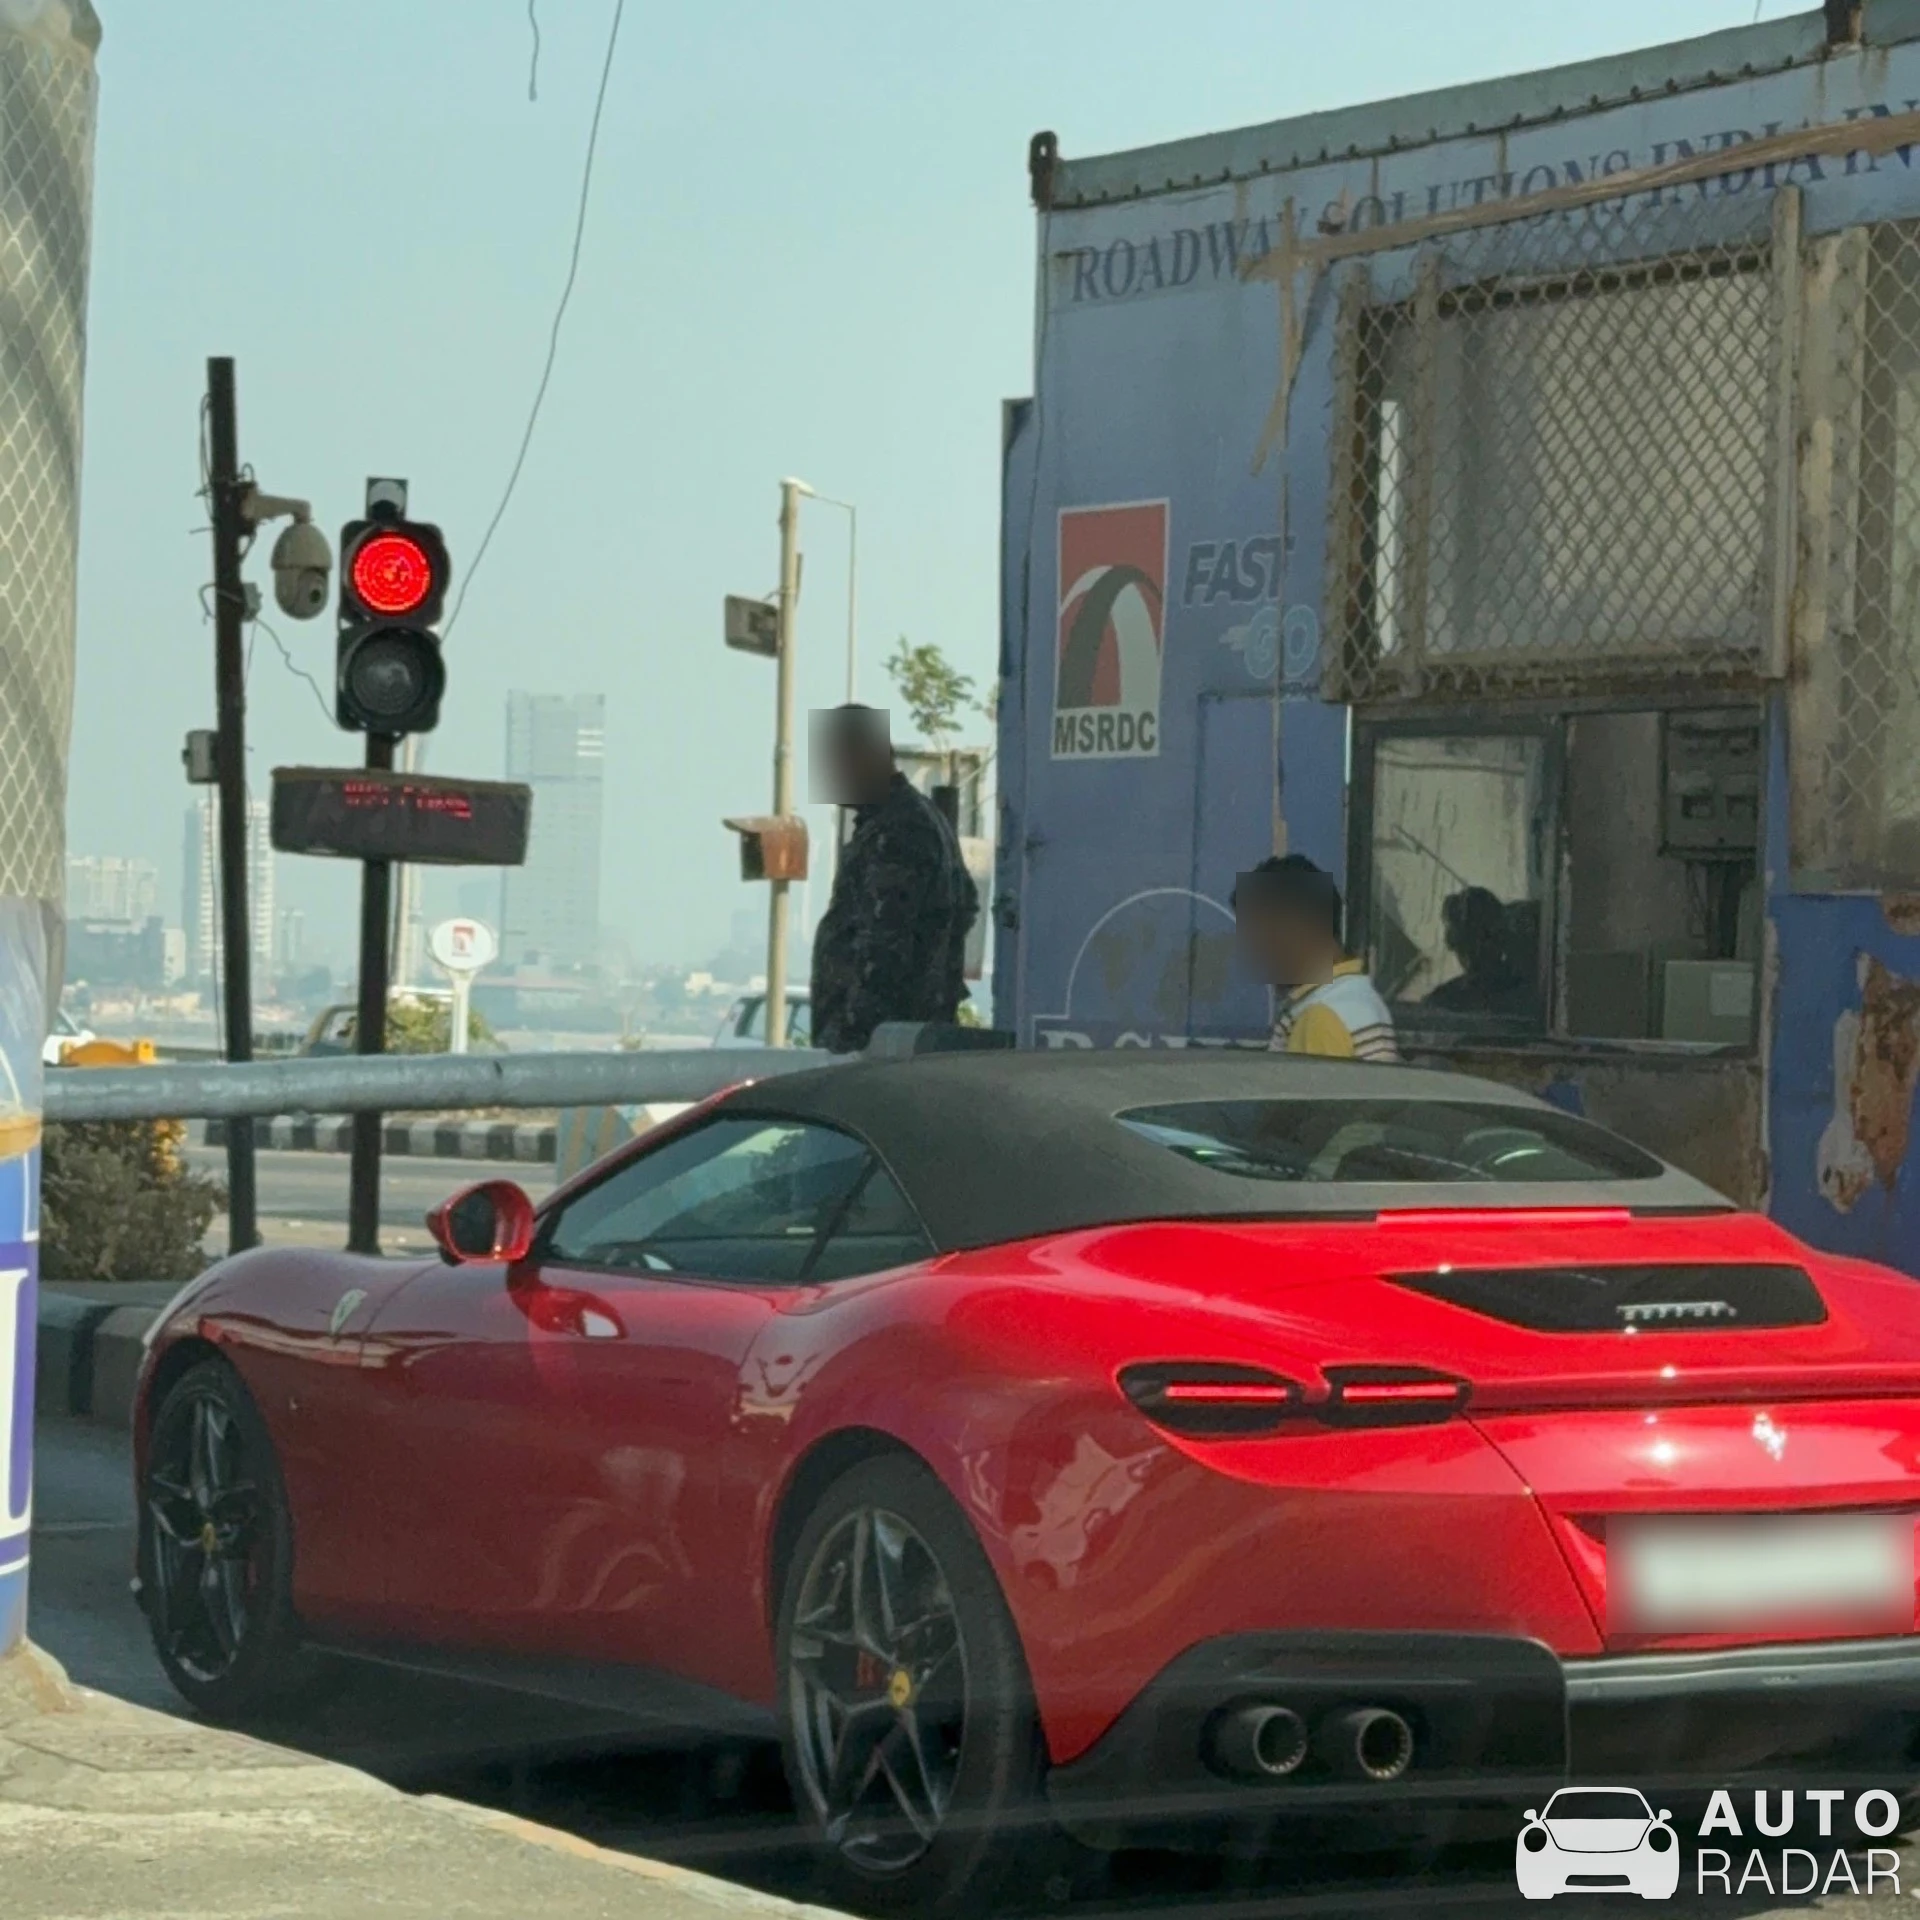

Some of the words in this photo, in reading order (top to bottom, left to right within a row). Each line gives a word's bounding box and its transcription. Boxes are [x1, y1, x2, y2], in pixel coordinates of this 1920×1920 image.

[1072, 206, 1309, 302] ROADWA
[1181, 534, 1298, 607] FAST
[1053, 711, 1157, 754] MSRDC
